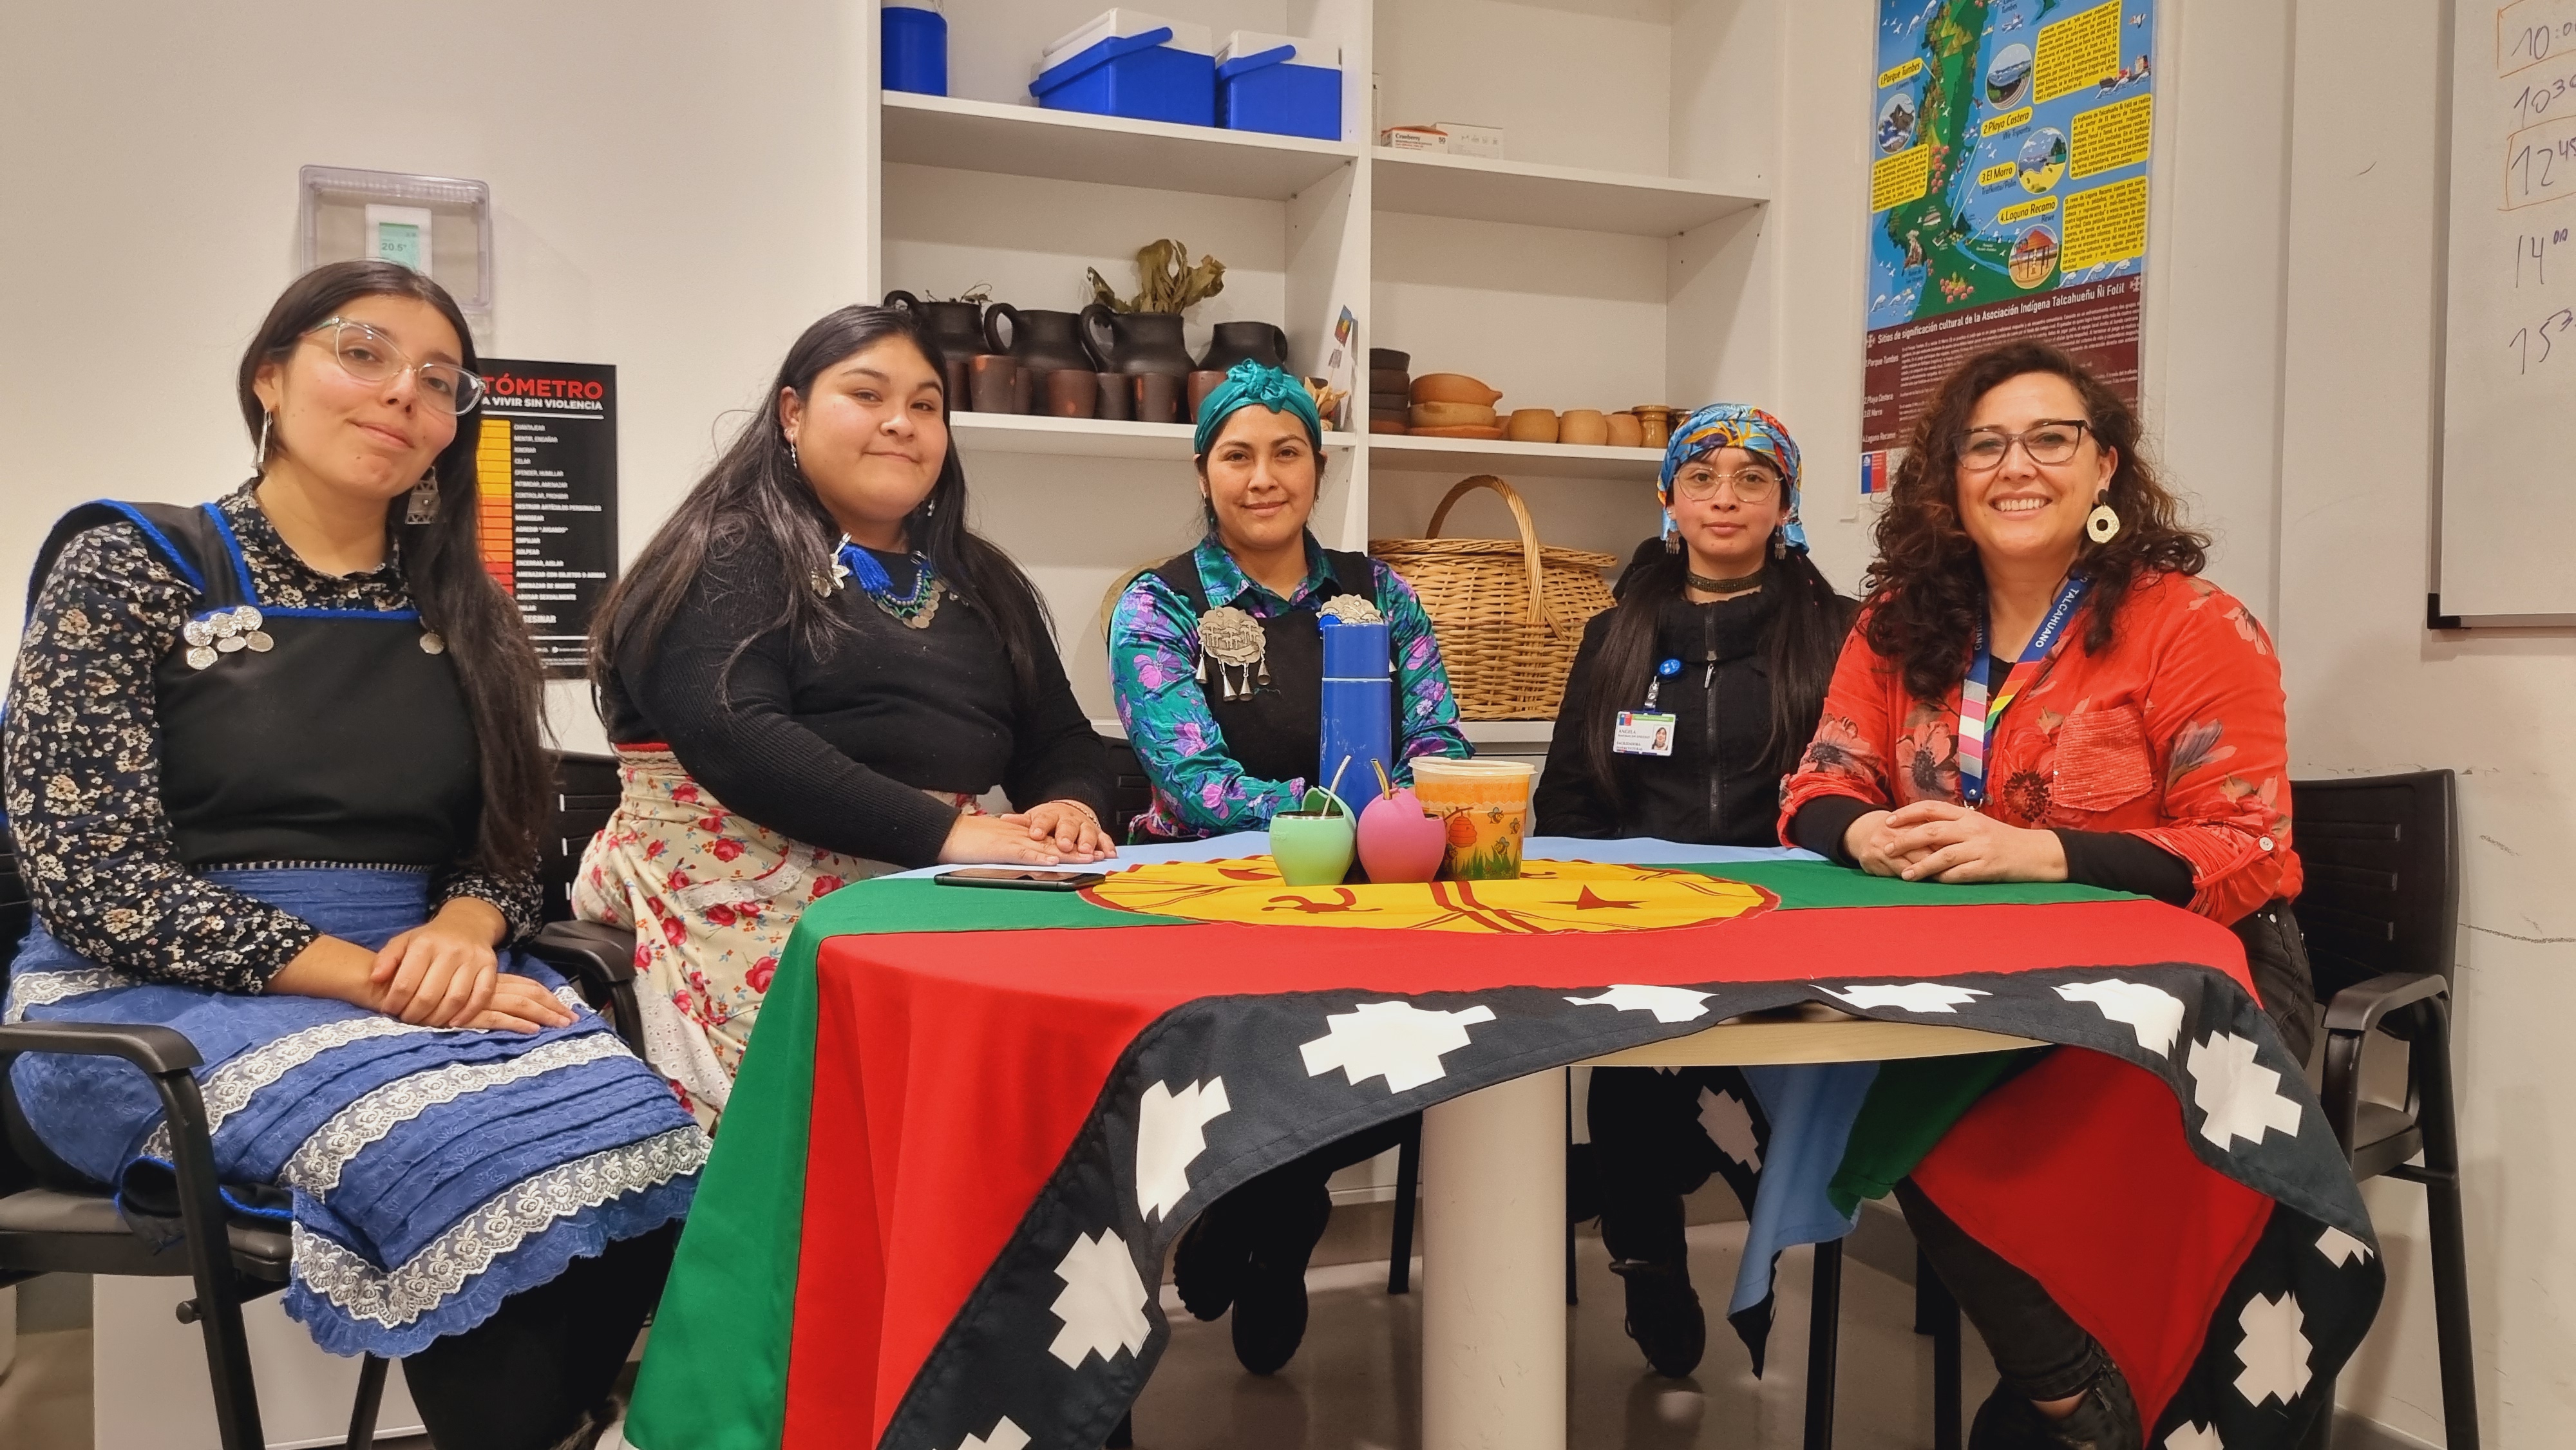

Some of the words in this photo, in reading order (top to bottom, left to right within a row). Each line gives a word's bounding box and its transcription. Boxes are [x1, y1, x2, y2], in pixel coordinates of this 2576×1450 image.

[2511, 22, 2576, 60] 10:0
[1902, 63, 1920, 75] Tumbes
[1984, 120, 2004, 134] 2.Playa
[2007, 112, 2029, 126] Costera
[1994, 165, 2012, 178] Morro
[2000, 209, 2029, 222] 4.Laguna
[2030, 201, 2055, 214] Recamo
[1878, 330, 1893, 344] Sitios
[1895, 330, 1901, 340] de
[1902, 321, 1937, 339] significación
[1939, 315, 1964, 331] cultural
[1965, 315, 1972, 325] de
[1974, 314, 1980, 322] la
[1982, 306, 2018, 322] Asociación
[2020, 299, 2050, 314] Indígena
[2052, 289, 2094, 307] Talcahueñu
[2097, 285, 2104, 297] Ñi
[2107, 283, 2125, 295] Folil
[482, 373, 603, 399] TÓMETRO
[492, 397, 522, 406] VIVIR
[524, 399, 543, 408] SIN
[544, 399, 603, 410] VIOLENCIA
[523, 615, 556, 623] SESINAR
[2035, 588, 2079, 648] TALCAHUANO
